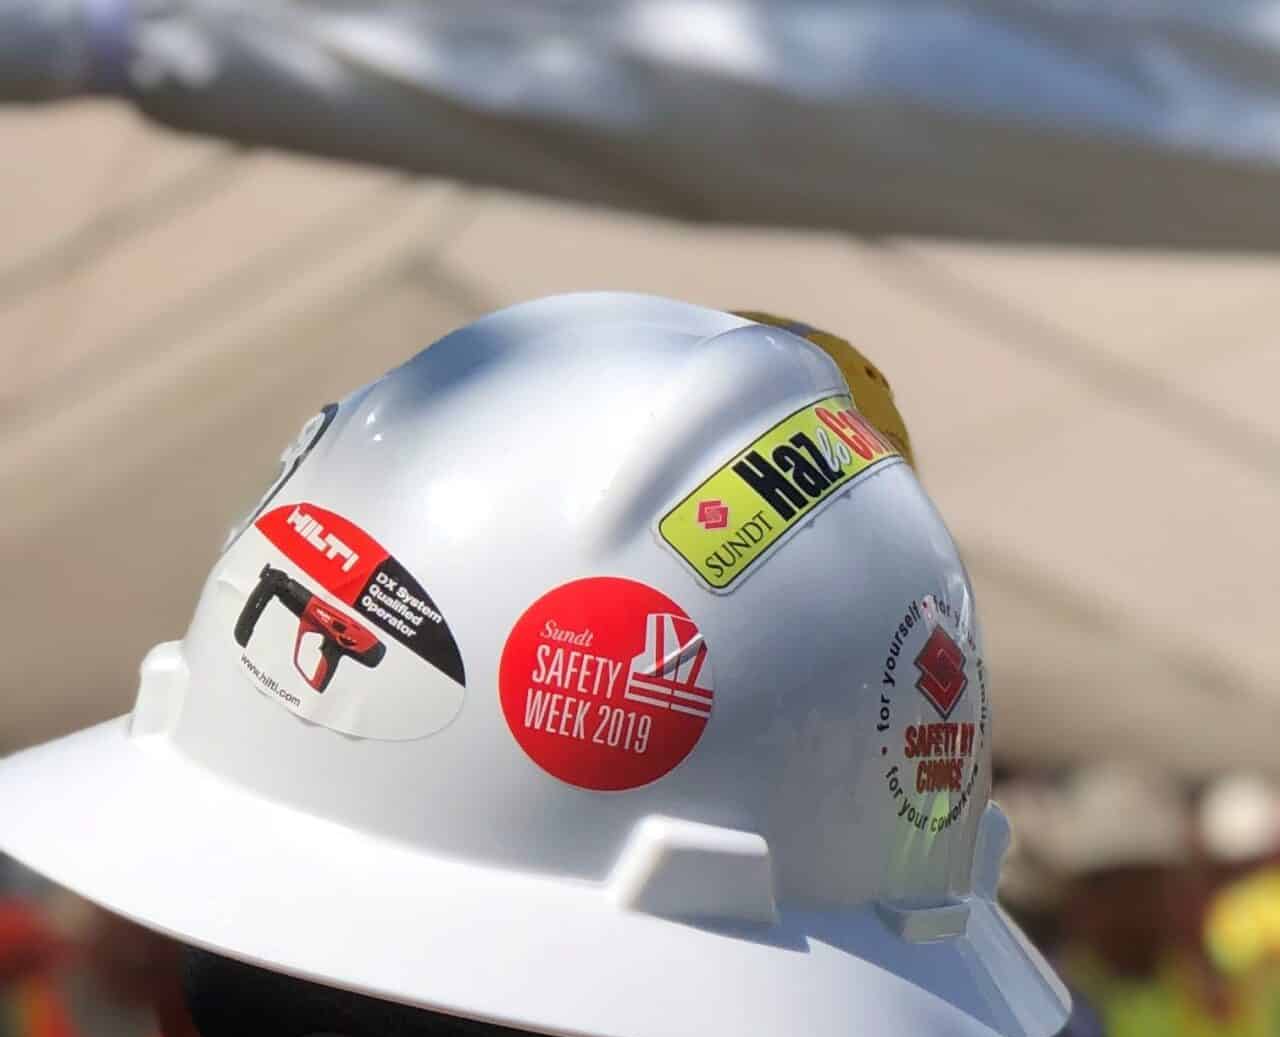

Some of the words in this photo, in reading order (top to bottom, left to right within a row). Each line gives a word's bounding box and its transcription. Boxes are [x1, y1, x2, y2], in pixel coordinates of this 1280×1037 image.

[732, 432, 845, 522] Haz
[287, 505, 360, 572] HILTI
[705, 511, 774, 578] SUNDT
[361, 595, 417, 638] Operator
[368, 583, 424, 626] Qualified
[375, 571, 398, 591] DX
[395, 585, 443, 624] System
[540, 618, 594, 648] Sundt
[882, 599, 921, 688] yourself
[532, 644, 623, 699] SAFETY
[523, 687, 592, 741] WEEK
[592, 704, 652, 754] 2019
[877, 693, 891, 732] for
[886, 765, 903, 798] for
[898, 798, 928, 831] your
